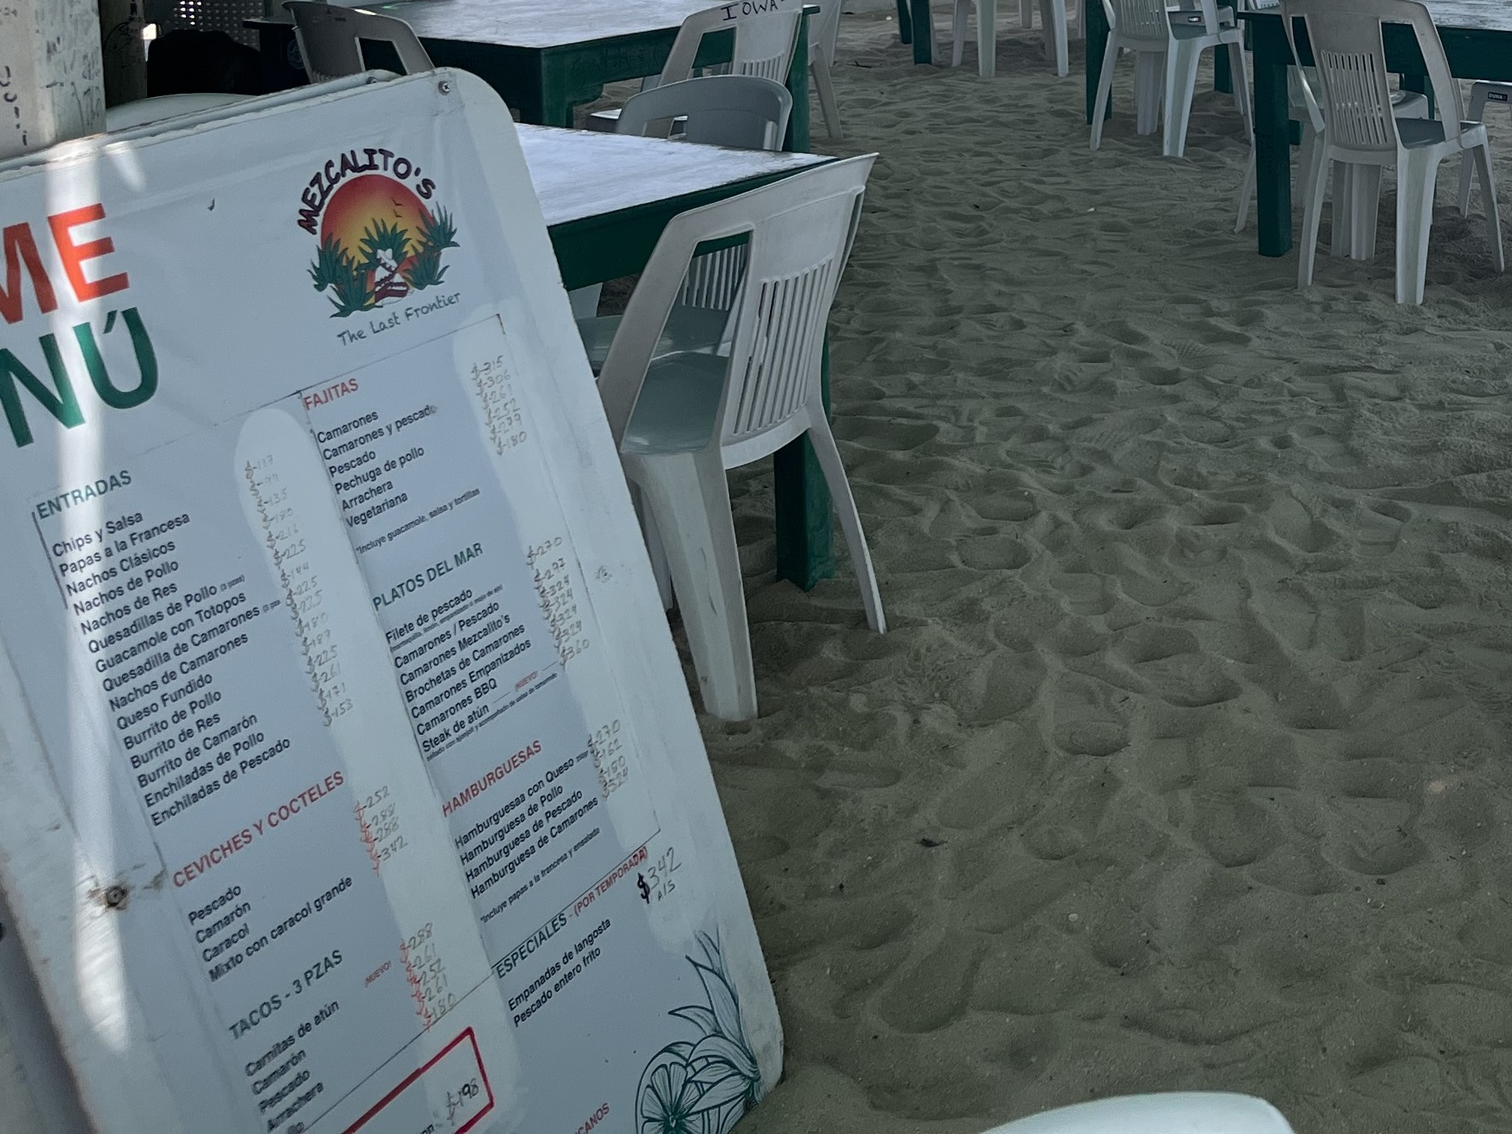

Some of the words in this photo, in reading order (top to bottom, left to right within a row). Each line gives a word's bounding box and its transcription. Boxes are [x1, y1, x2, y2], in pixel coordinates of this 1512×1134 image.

[297, 148, 436, 235] MEZCALITO'S
[0, 202, 130, 325] ME
[338, 327, 368, 348] The
[369, 312, 402, 336] Last
[404, 290, 462, 323] Frontier
[0, 306, 159, 448] NÚ
[299, 376, 359, 411] FAJITAS
[313, 410, 379, 444] Camarones
[318, 426, 385, 461] Camarones
[34, 468, 132, 520] ENTRADAS
[326, 449, 377, 479] Pescado
[332, 465, 383, 496] Pechuga
[382, 458, 398, 473] de
[397, 446, 425, 469] pollo
[340, 479, 394, 513] Arrachera
[50, 532, 94, 558] Chips
[104, 511, 144, 535] Salsa
[343, 491, 409, 528] Vegetariana
[57, 550, 103, 578] Papas
[102, 545, 114, 558] a
[112, 539, 129, 553] la
[127, 512, 191, 547] Francesa
[64, 565, 119, 597] Nachos
[118, 539, 176, 573] Clásicos
[371, 572, 426, 612] PLATOS
[424, 558, 454, 583] DEL
[452, 541, 484, 568] MAR
[93, 629, 169, 674] Guacamole
[169, 616, 195, 637] con
[193, 591, 247, 623] Totopos
[101, 650, 172, 693] Quesadilla
[171, 641, 190, 657] de
[189, 605, 261, 647] Camarones
[383, 621, 415, 645] Filete
[414, 612, 430, 627] de
[429, 587, 473, 622] pescado
[392, 629, 453, 669] Camarones
[456, 601, 500, 632] Pescado
[398, 645, 458, 686] Camarones
[456, 613, 511, 652] Mezcalito's
[107, 678, 159, 713] Nachos
[159, 669, 178, 686] de
[177, 632, 249, 675] Camarones
[403, 665, 457, 704] Brochetas
[457, 656, 472, 671] de
[470, 623, 526, 662] Camarones
[409, 677, 468, 719] Camarones
[466, 638, 532, 684] Empanizados
[115, 701, 160, 731] Queso
[158, 672, 213, 708] Fundido
[121, 718, 169, 751] Burrito
[169, 708, 188, 725] de
[186, 690, 222, 715] Pollo
[415, 693, 474, 736] Camarones
[472, 676, 498, 700] BBQ
[420, 726, 453, 753] Steak
[451, 718, 467, 734] de
[465, 703, 490, 725] atún
[135, 755, 183, 789] Burrito
[183, 745, 202, 762] de
[201, 713, 258, 751] Camarón
[149, 778, 221, 827] Enchiladas
[221, 768, 239, 785] de
[237, 737, 291, 775] Pescado
[440, 738, 542, 818] HAMBURGUESAS
[172, 827, 253, 888] CEVICHES
[251, 817, 264, 836] Y
[266, 769, 344, 828] COCTELES
[463, 827, 532, 884] Hamburguesa
[530, 817, 545, 834] de
[543, 789, 583, 824] Pescado
[469, 843, 537, 900] Hamburguesa
[535, 833, 550, 849] de
[548, 795, 599, 839] Camarones
[186, 884, 242, 926] Pescado
[244, 934, 269, 957] con
[269, 900, 313, 940] caracol
[312, 875, 353, 913] grande
[201, 921, 250, 963] Caracol
[494, 911, 568, 980] ESPECIALES
[506, 960, 562, 1012] Empanadas
[560, 949, 574, 966] de
[572, 917, 612, 955] langosta
[227, 993, 283, 1040] TACOS
[291, 977, 303, 995] 3
[302, 948, 343, 987] PZAS
[512, 988, 553, 1028] Pescado
[552, 962, 583, 993] entero
[580, 946, 601, 968] frito
